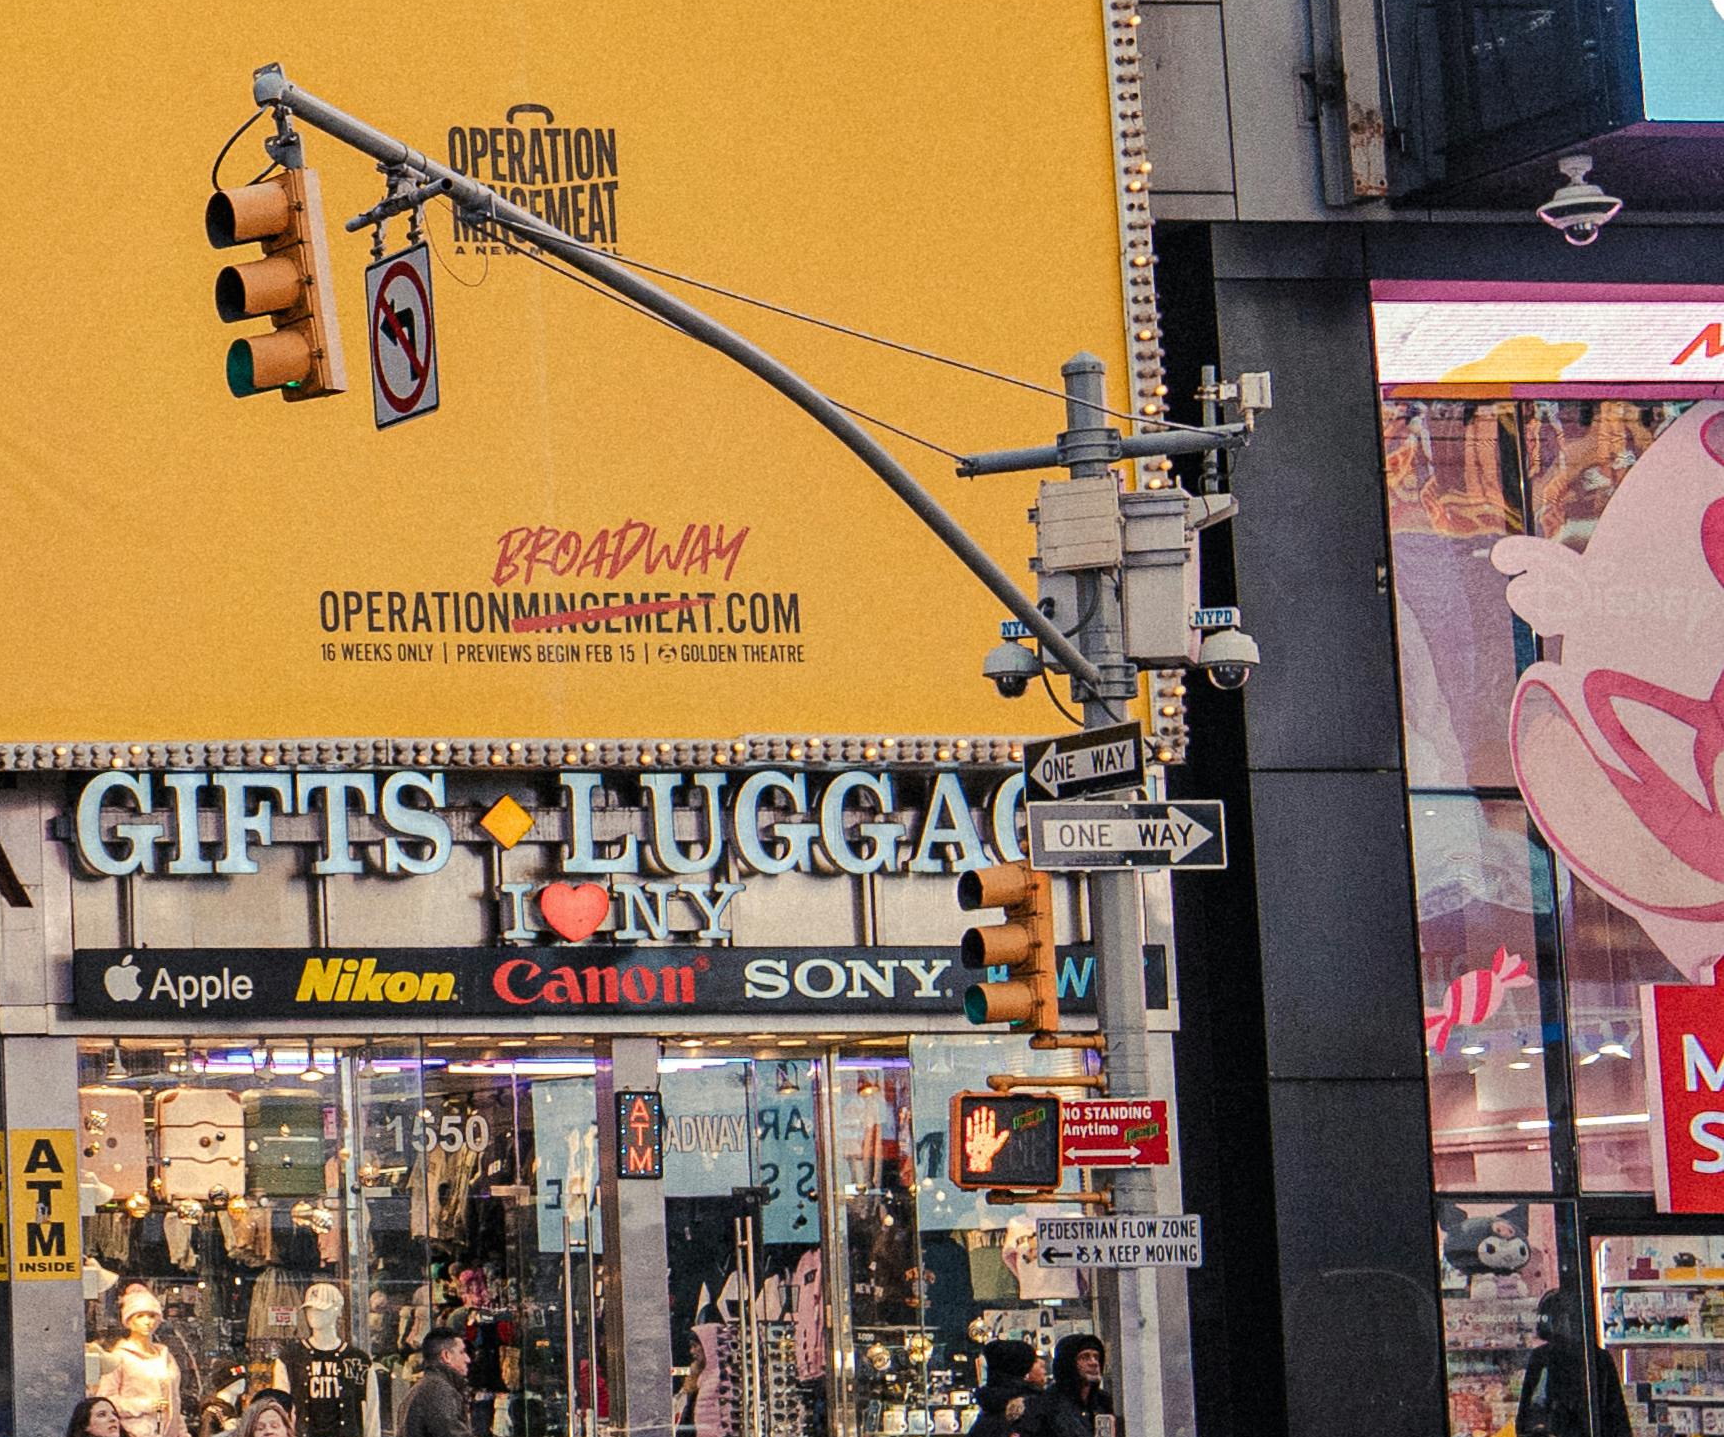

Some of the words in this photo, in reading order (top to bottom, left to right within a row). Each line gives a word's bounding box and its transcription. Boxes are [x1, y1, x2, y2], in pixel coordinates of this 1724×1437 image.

[447, 126, 618, 179] OPERATION
[491, 518, 750, 588] BROADWAY
[1194, 609, 1234, 624] NYPD
[321, 642, 336, 664] 16
[341, 642, 396, 664] WEEKS
[397, 642, 434, 664] ONLY
[456, 642, 532, 664] PREVIEWS
[536, 642, 580, 664] BEGIN
[584, 642, 613, 664] FEB
[618, 642, 636, 664] 15
[681, 642, 738, 664] GOLDEN
[741, 642, 805, 664] THEATRE
[1042, 754, 1077, 784] ONE
[1091, 743, 1128, 774] WAY
[78, 771, 453, 878] GIFTS
[559, 768, 1027, 877] LUGGA
[1058, 824, 1112, 847] ONE
[1137, 822, 1194, 847] WAY
[617, 883, 746, 942] NY
[149, 966, 255, 1004] Apple
[295, 957, 455, 1003] Nikon
[492, 958, 698, 1006] Canon
[743, 958, 946, 1000] SONY
[1062, 1107, 1081, 1121] NO
[1083, 1105, 1152, 1121] STANDING
[1062, 1123, 1119, 1137] Anytime
[385, 1115, 490, 1153] 1550
[628, 1096, 654, 1173] ATM
[23, 1138, 67, 1257] ATM
[1038, 1220, 1119, 1240] PEDESTRIAN
[1121, 1220, 1159, 1240] FLOW
[1161, 1218, 1197, 1239] ZONE
[19, 1261, 76, 1273] INSIDE
[1108, 1245, 1140, 1263] KEEP
[1145, 1244, 1198, 1263] MOVING
